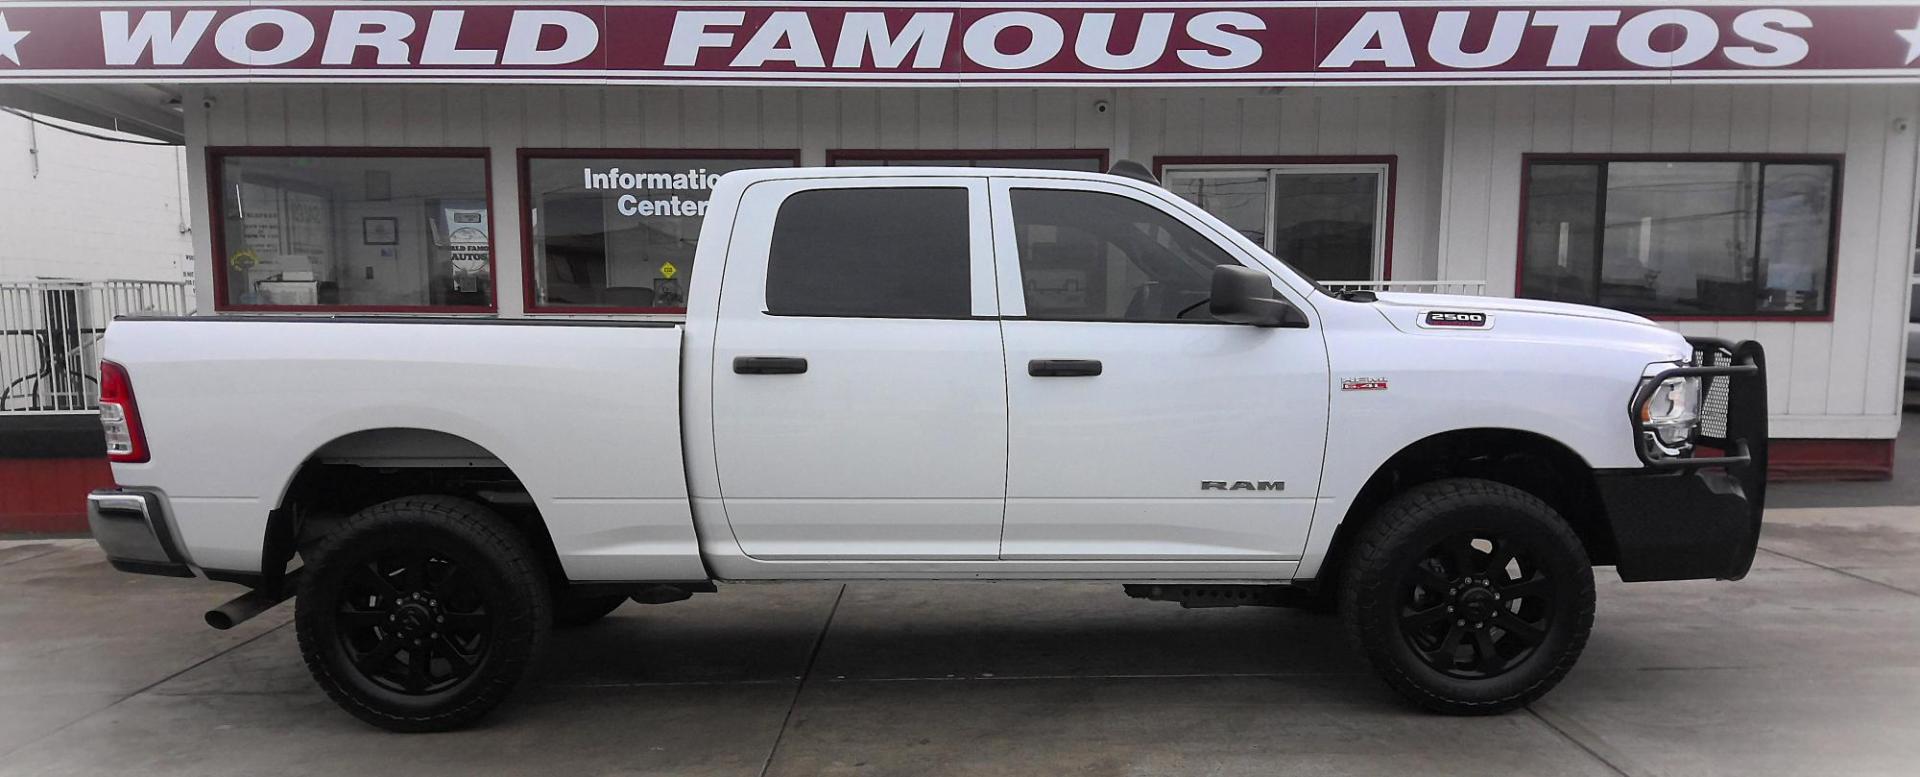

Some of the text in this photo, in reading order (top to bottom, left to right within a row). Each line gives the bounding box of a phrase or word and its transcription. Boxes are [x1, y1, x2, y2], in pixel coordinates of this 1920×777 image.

[100, 8, 1813, 70] WORLD FAMOUS AUTOS
[584, 168, 721, 190] Informatio
[617, 194, 710, 216] Center
[451, 253, 488, 261] AUTOS
[1431, 313, 1482, 322] 2500
[1201, 481, 1285, 491] RAM
